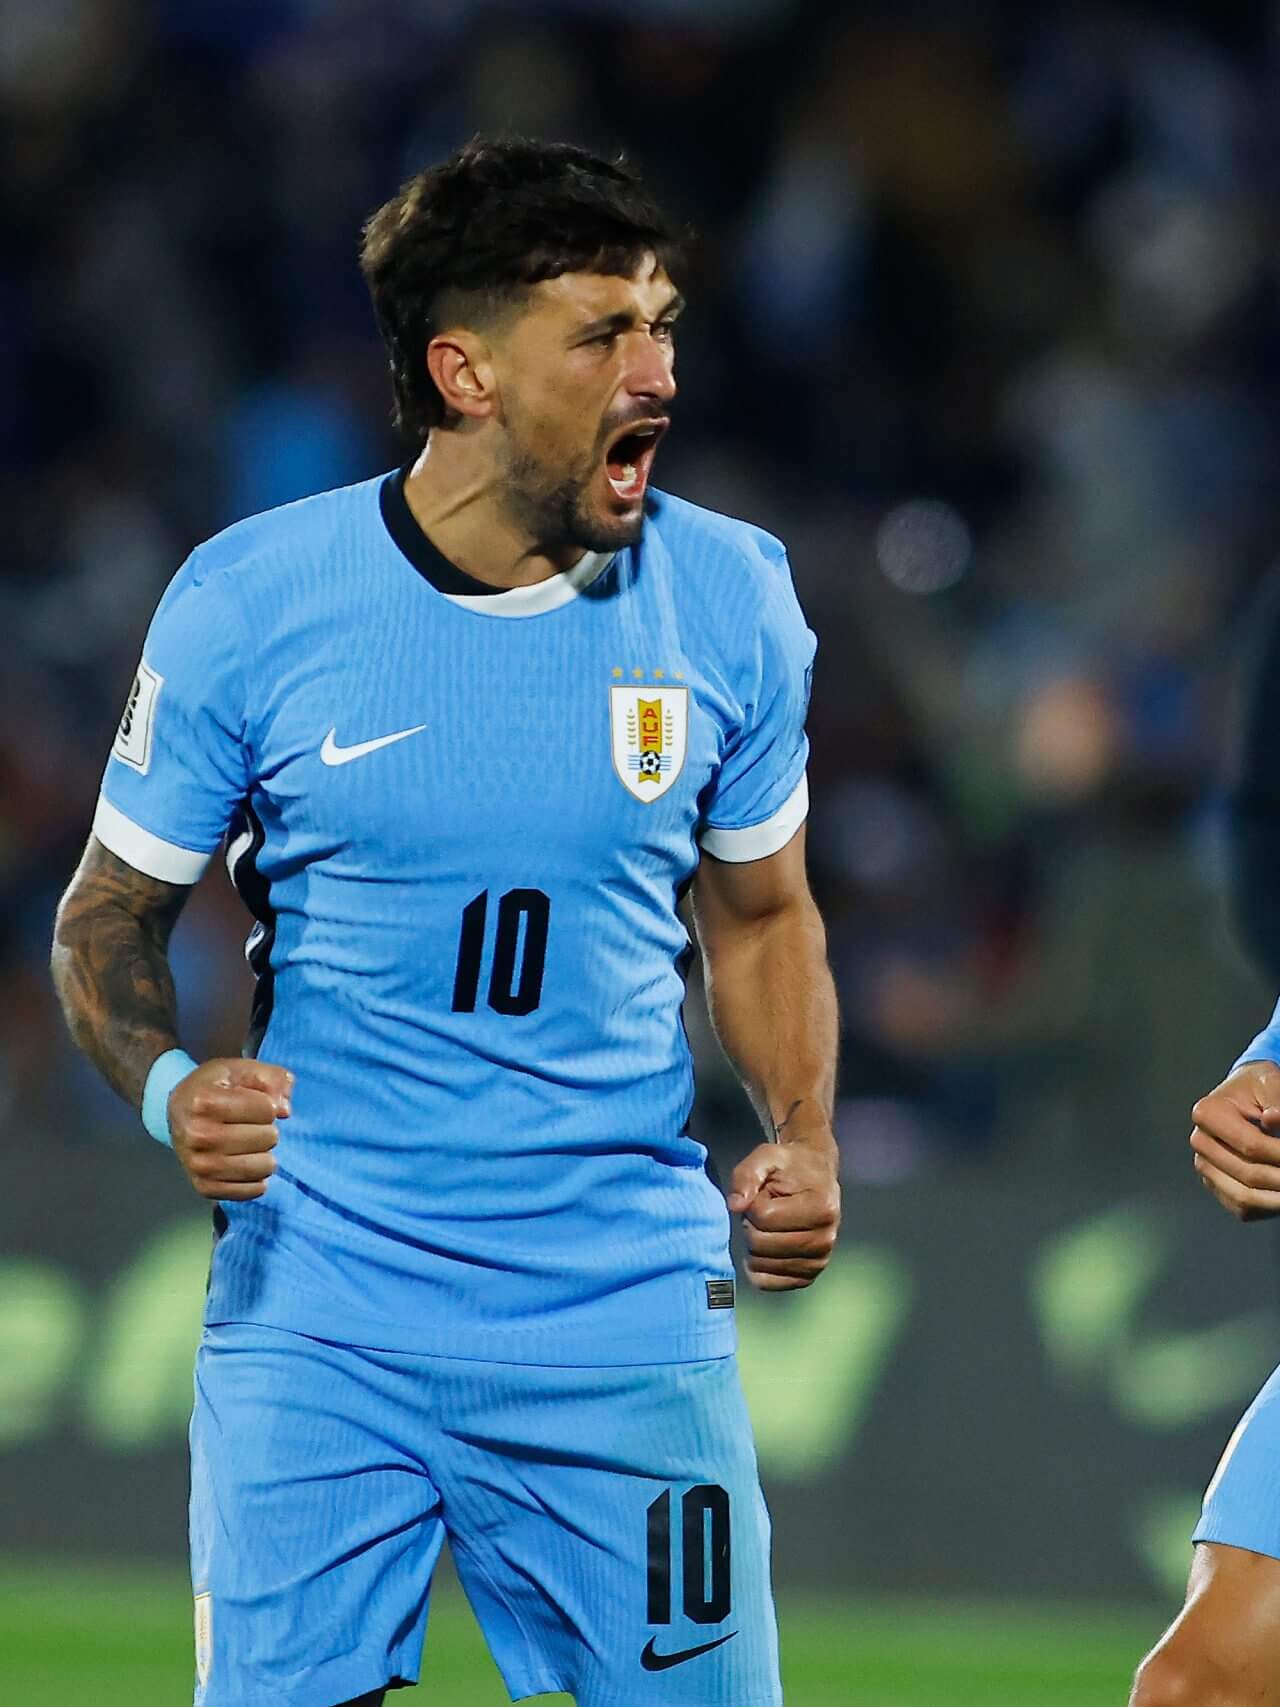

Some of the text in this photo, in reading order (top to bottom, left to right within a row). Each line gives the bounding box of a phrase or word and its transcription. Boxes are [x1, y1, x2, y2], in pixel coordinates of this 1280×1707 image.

[642, 707, 660, 747] AUF
[451, 888, 551, 1016] 10
[647, 1484, 732, 1625] 10
